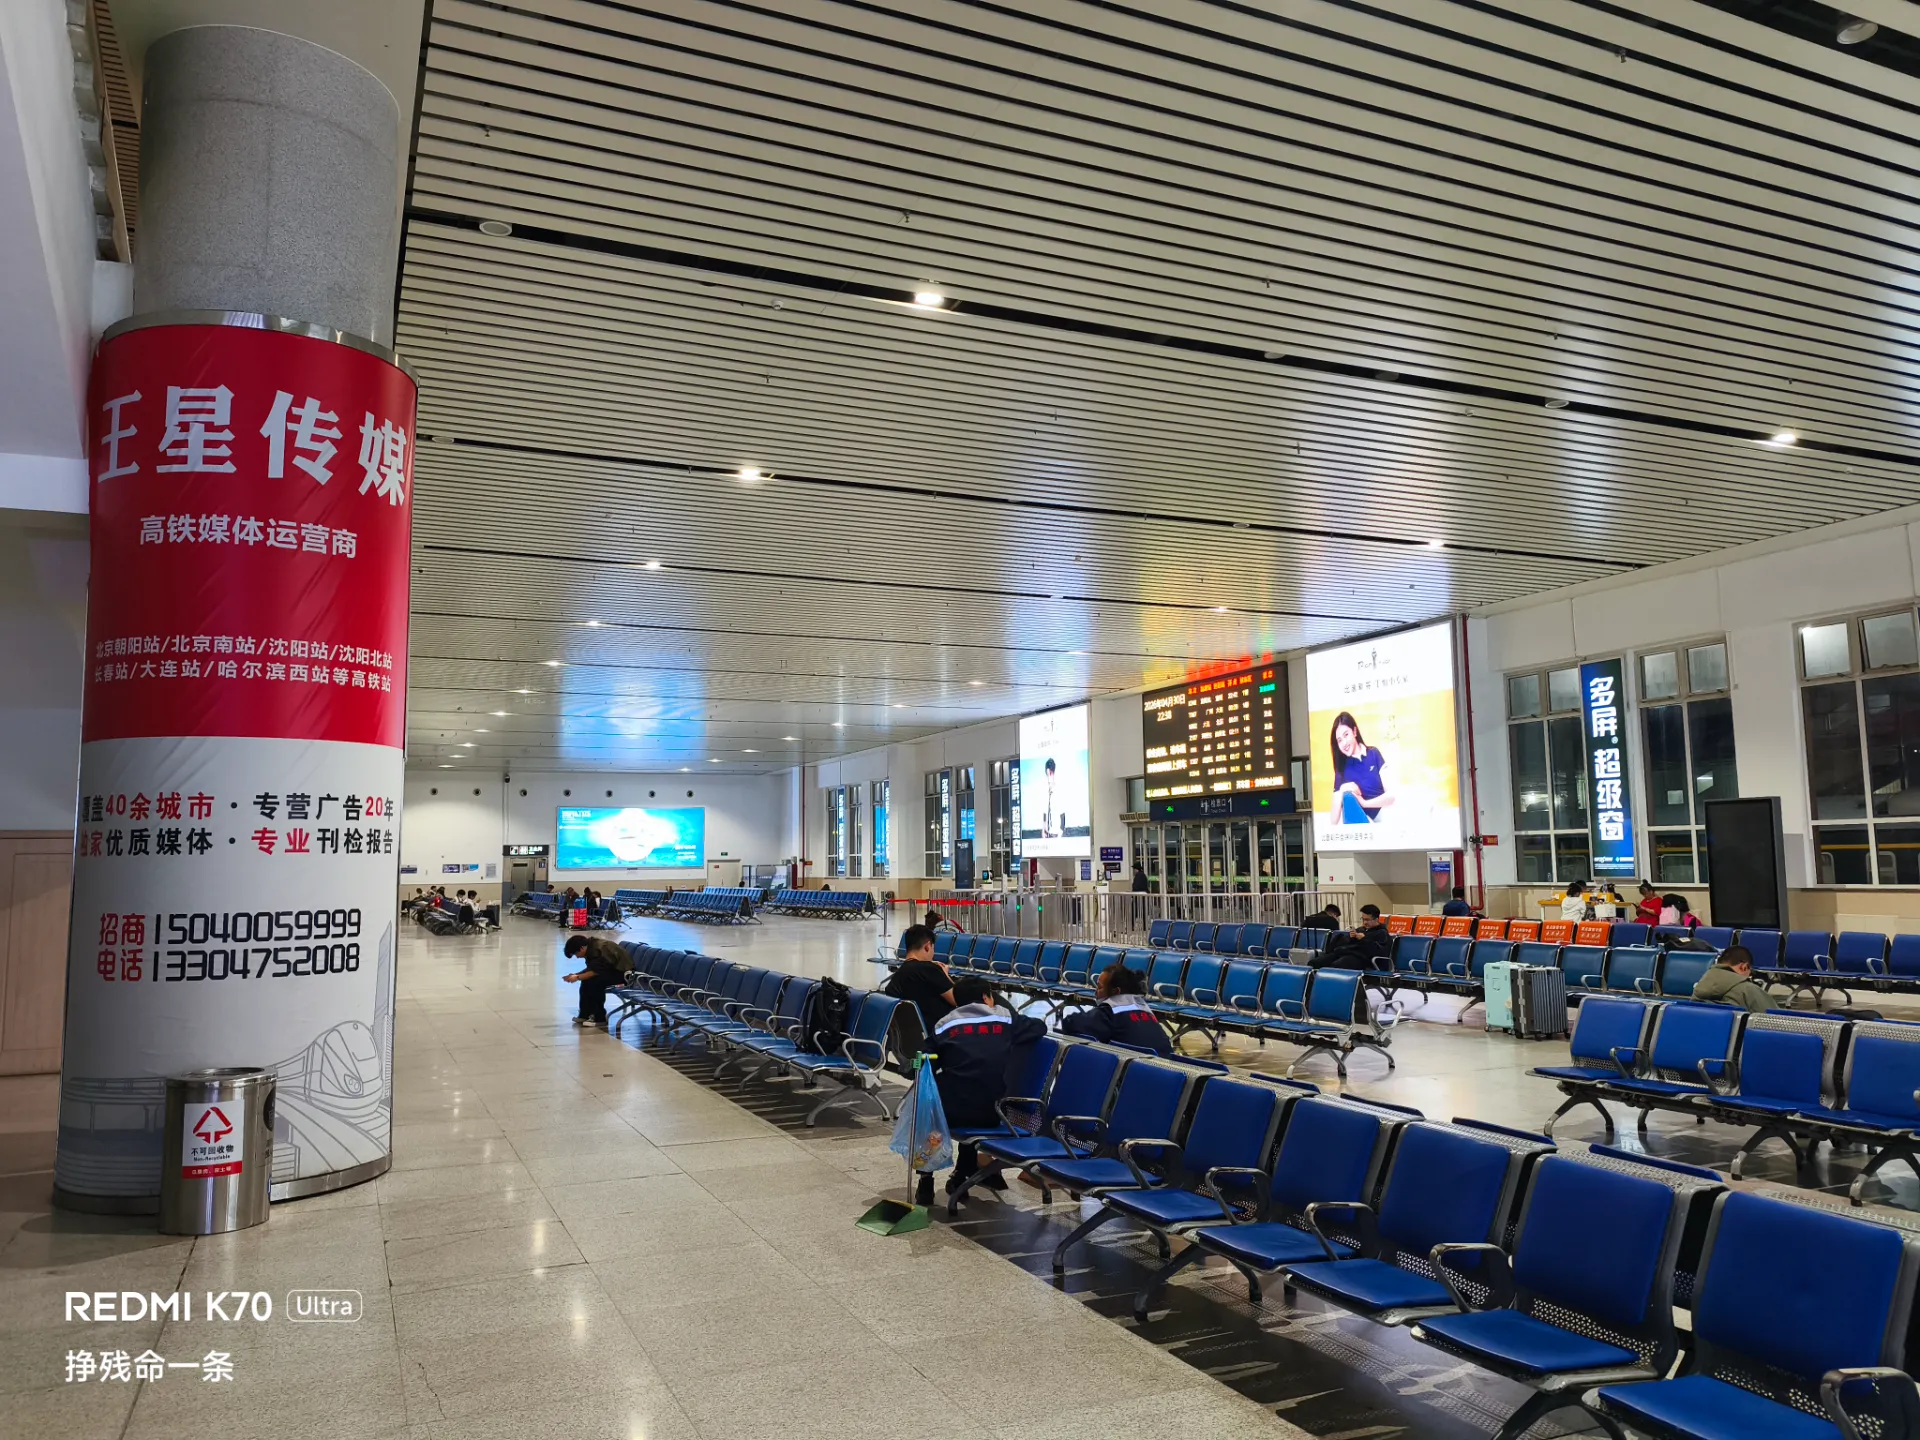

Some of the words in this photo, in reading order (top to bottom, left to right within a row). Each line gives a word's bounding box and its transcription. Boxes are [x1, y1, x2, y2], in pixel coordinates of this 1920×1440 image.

[139, 514, 358, 559] 高铁媒体运营商
[95, 634, 393, 670] 北京朝阳站/北京南站/沈阳站/沈阳北站
[98, 912, 146, 947] 招商
[154, 908, 362, 945] 15040059999
[96, 949, 144, 983] 电话
[152, 943, 360, 983] 13304752008
[190, 1144, 234, 1156] 不可回收物
